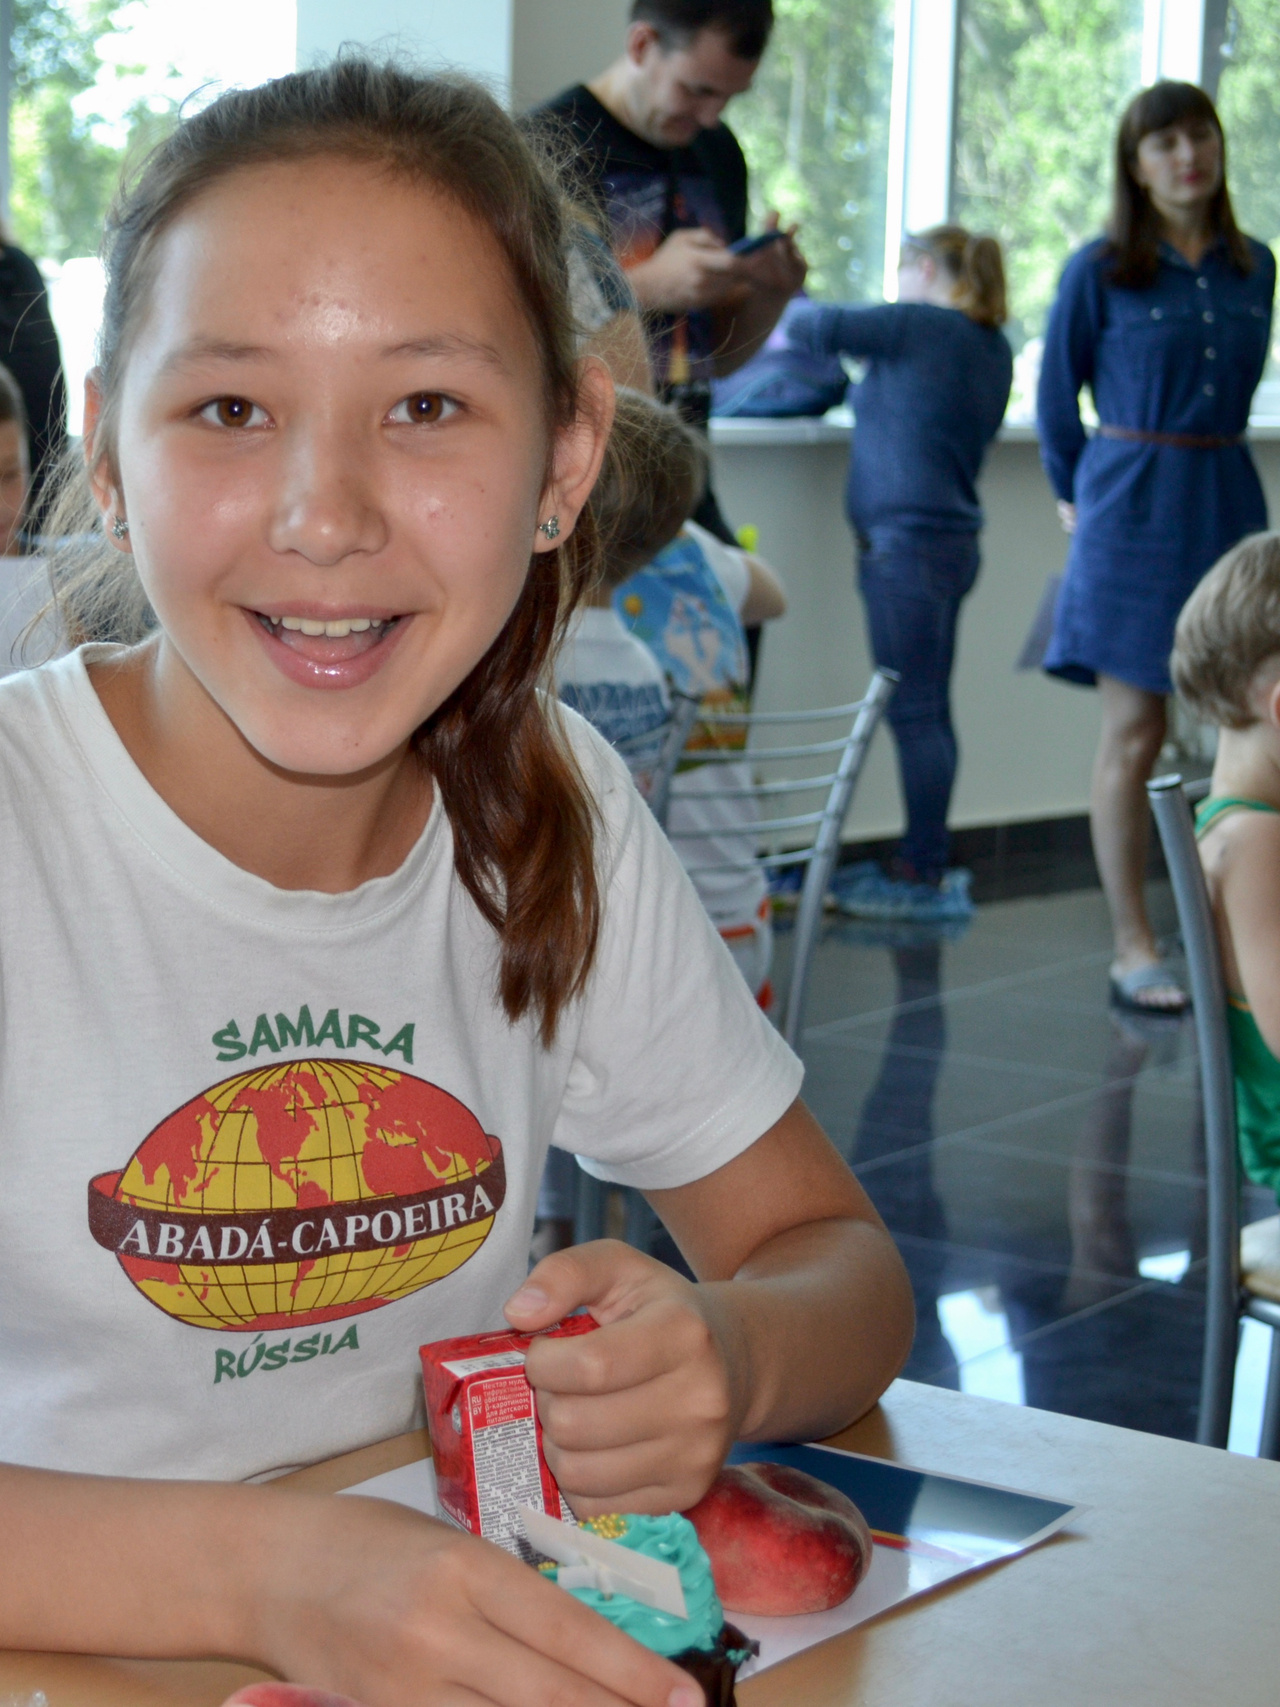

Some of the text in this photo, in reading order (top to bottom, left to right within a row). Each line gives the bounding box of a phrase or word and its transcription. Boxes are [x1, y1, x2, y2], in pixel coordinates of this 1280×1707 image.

[212, 1004, 416, 1064] SAMARA
[120, 1184, 495, 1261] ABADÁ-CAPOEIRA
[213, 1324, 360, 1384] RÚSSIA
[471, 1395, 482, 1404] RU
[473, 1406, 482, 1415] BY
[499, 1404, 529, 1416] детского
